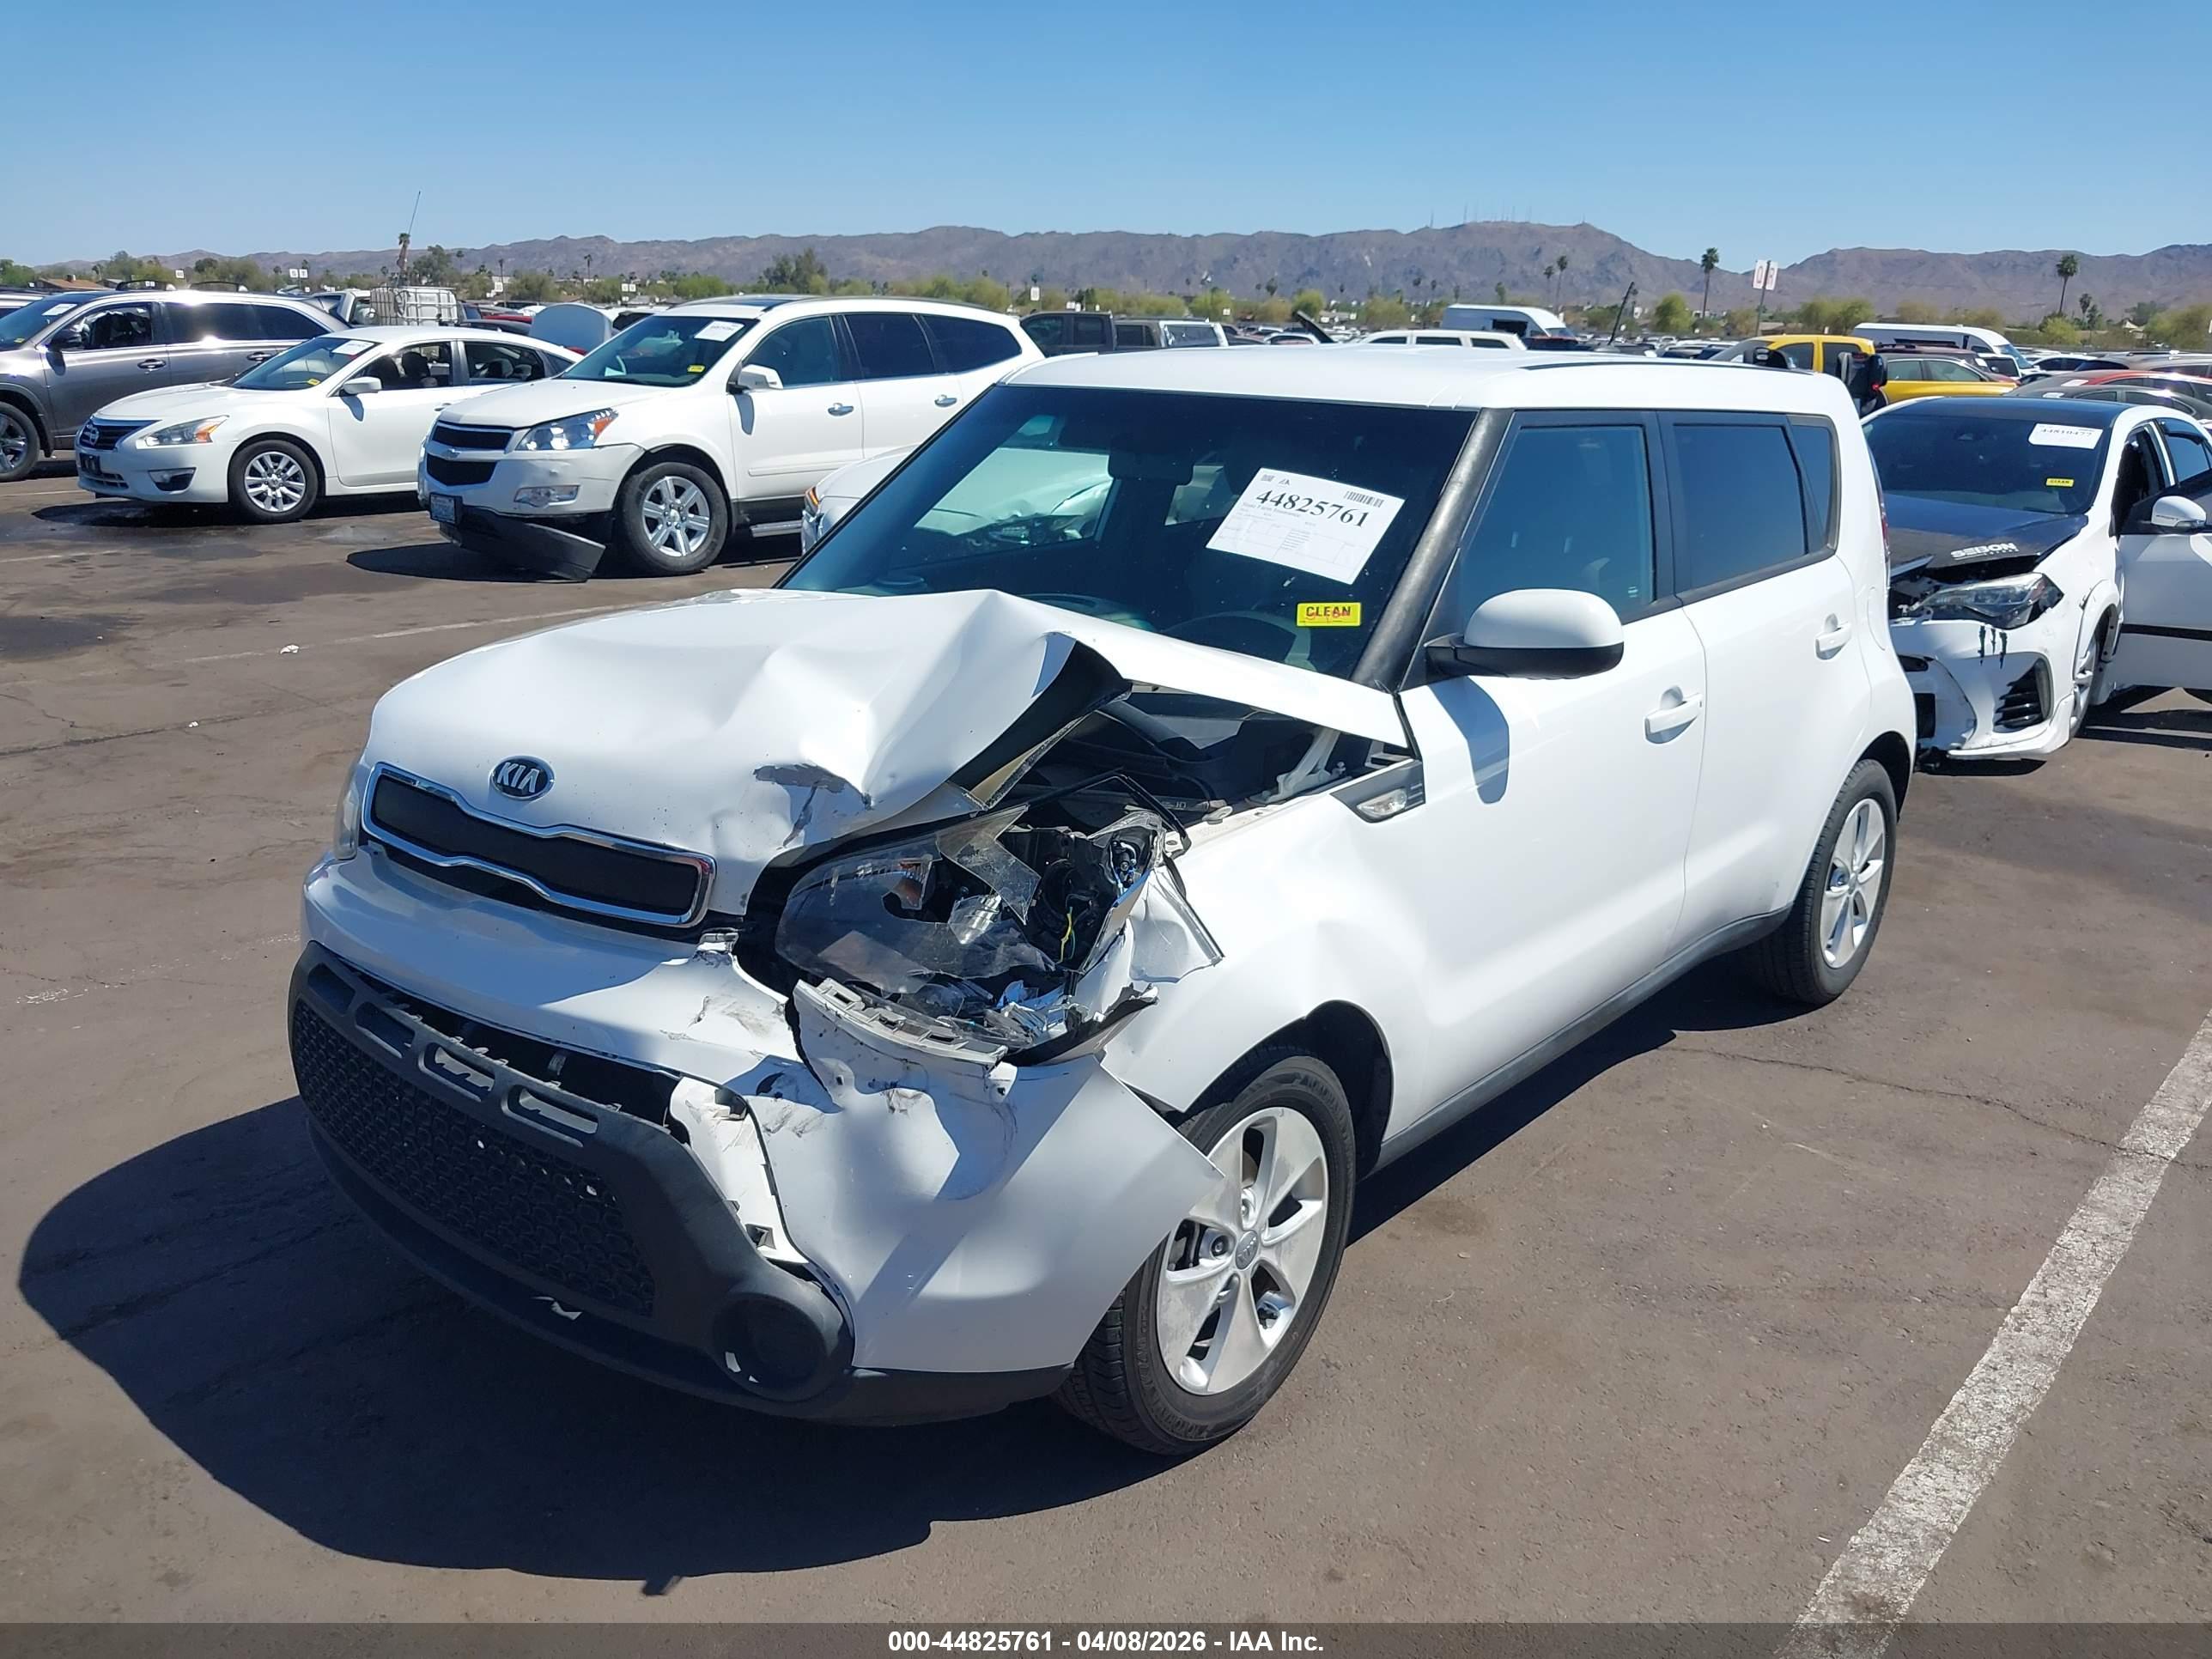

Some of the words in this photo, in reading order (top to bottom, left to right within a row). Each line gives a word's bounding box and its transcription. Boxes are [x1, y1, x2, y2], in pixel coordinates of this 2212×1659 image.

[1256, 489, 1370, 529] 44825761
[1950, 543, 2017, 558] SEBON
[1306, 606, 1352, 617] CLEAN
[497, 762, 540, 793] KIA
